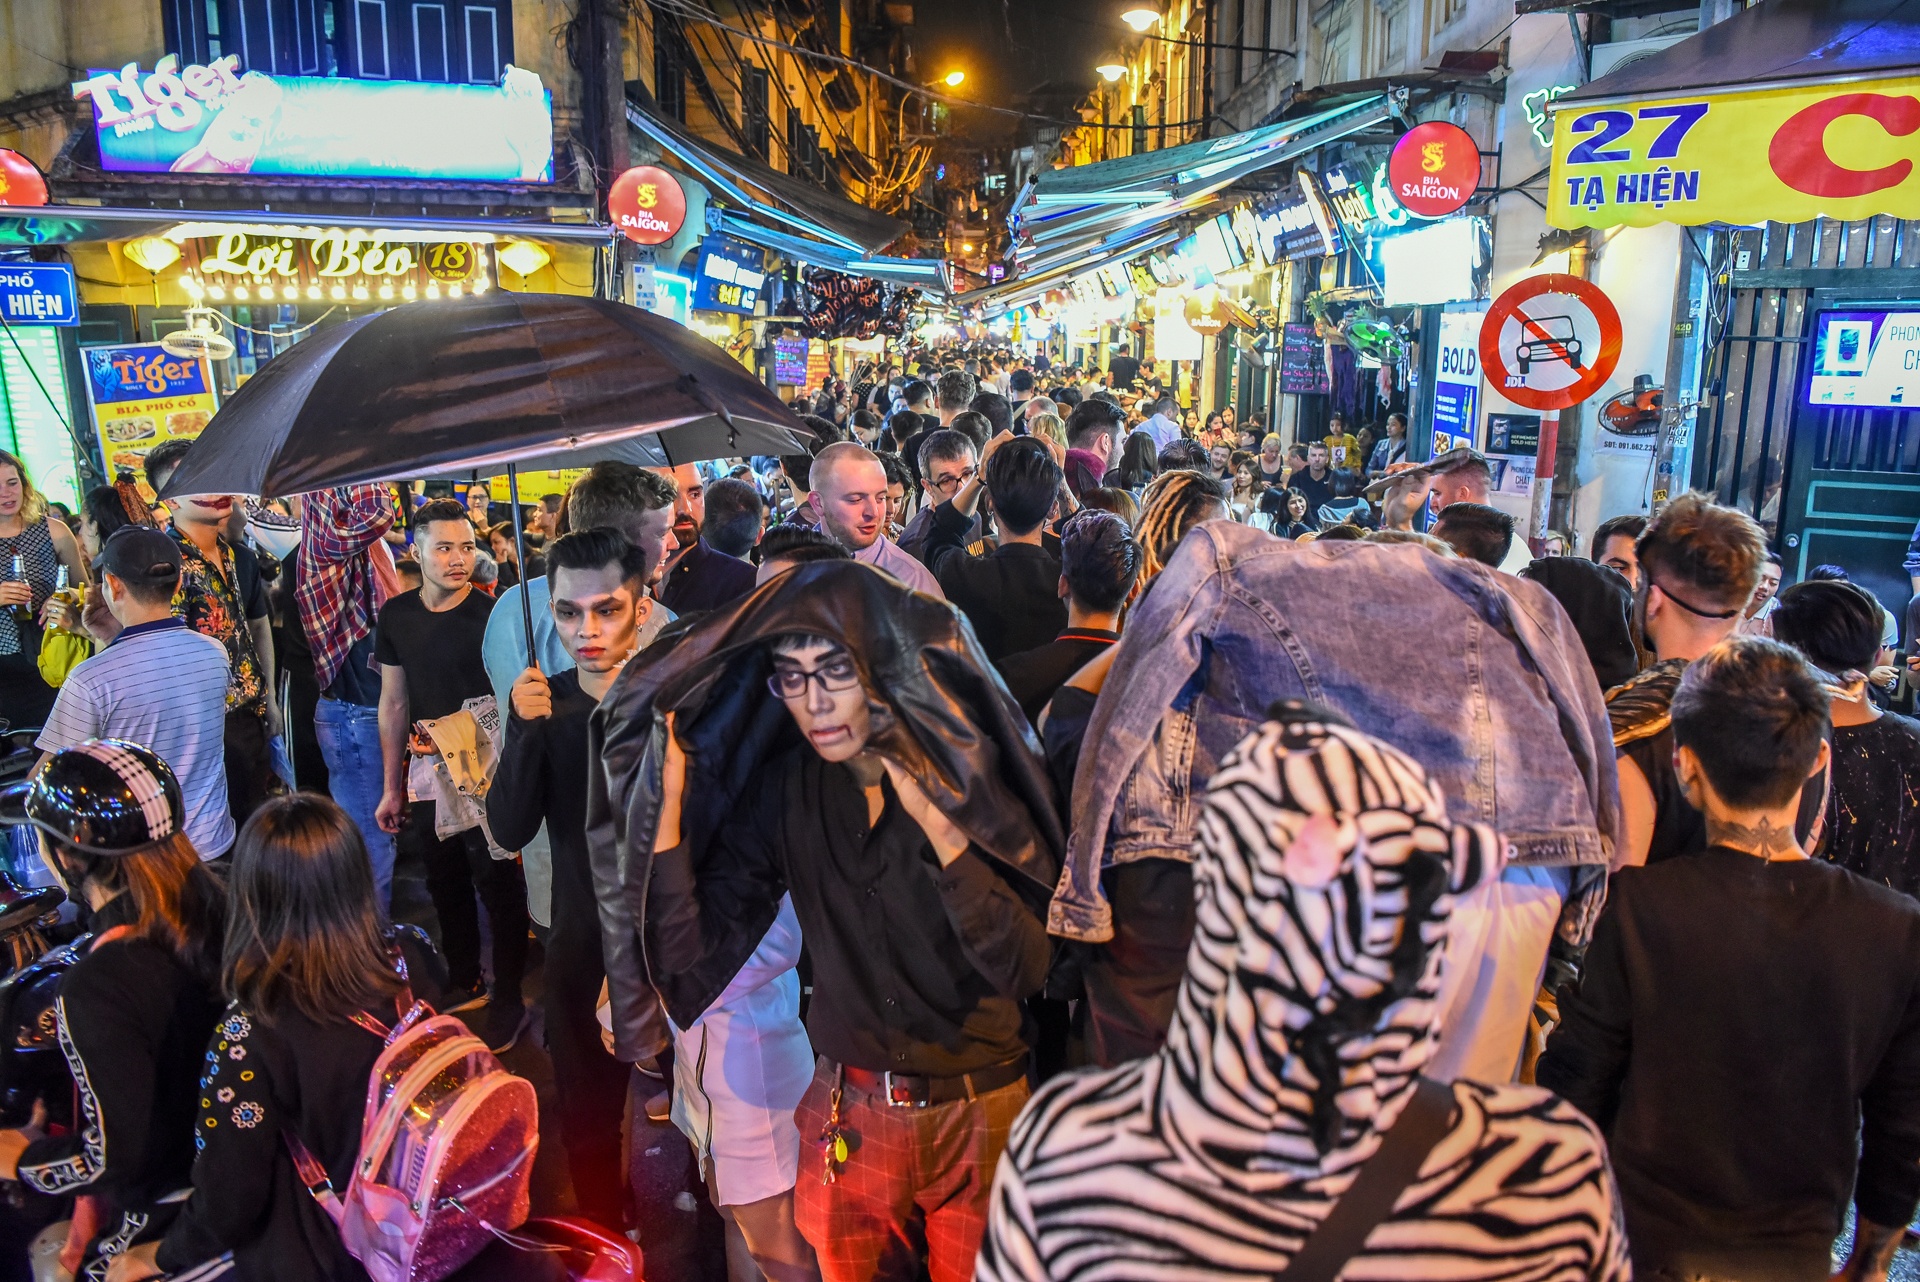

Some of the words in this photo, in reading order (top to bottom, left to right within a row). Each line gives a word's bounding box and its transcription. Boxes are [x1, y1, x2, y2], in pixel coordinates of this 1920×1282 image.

[71, 53, 247, 132] Tiger
[1567, 103, 1709, 164] 27
[1402, 183, 1459, 200] SAIGON
[1422, 176, 1441, 186] BIA
[1567, 177, 1605, 211] TẠ
[1616, 166, 1700, 209] HIỆN
[621, 214, 670, 232] SAIGON
[638, 210, 653, 219] BIA
[200, 232, 299, 284] Lợi
[311, 228, 418, 276] Béo
[430, 242, 467, 269] 18
[8, 290, 63, 320] HIỆN
[113, 354, 195, 393] Tiger
[1442, 346, 1476, 376] BOLD
[116, 405, 141, 415] BIA
[1668, 427, 1688, 436] HOT
